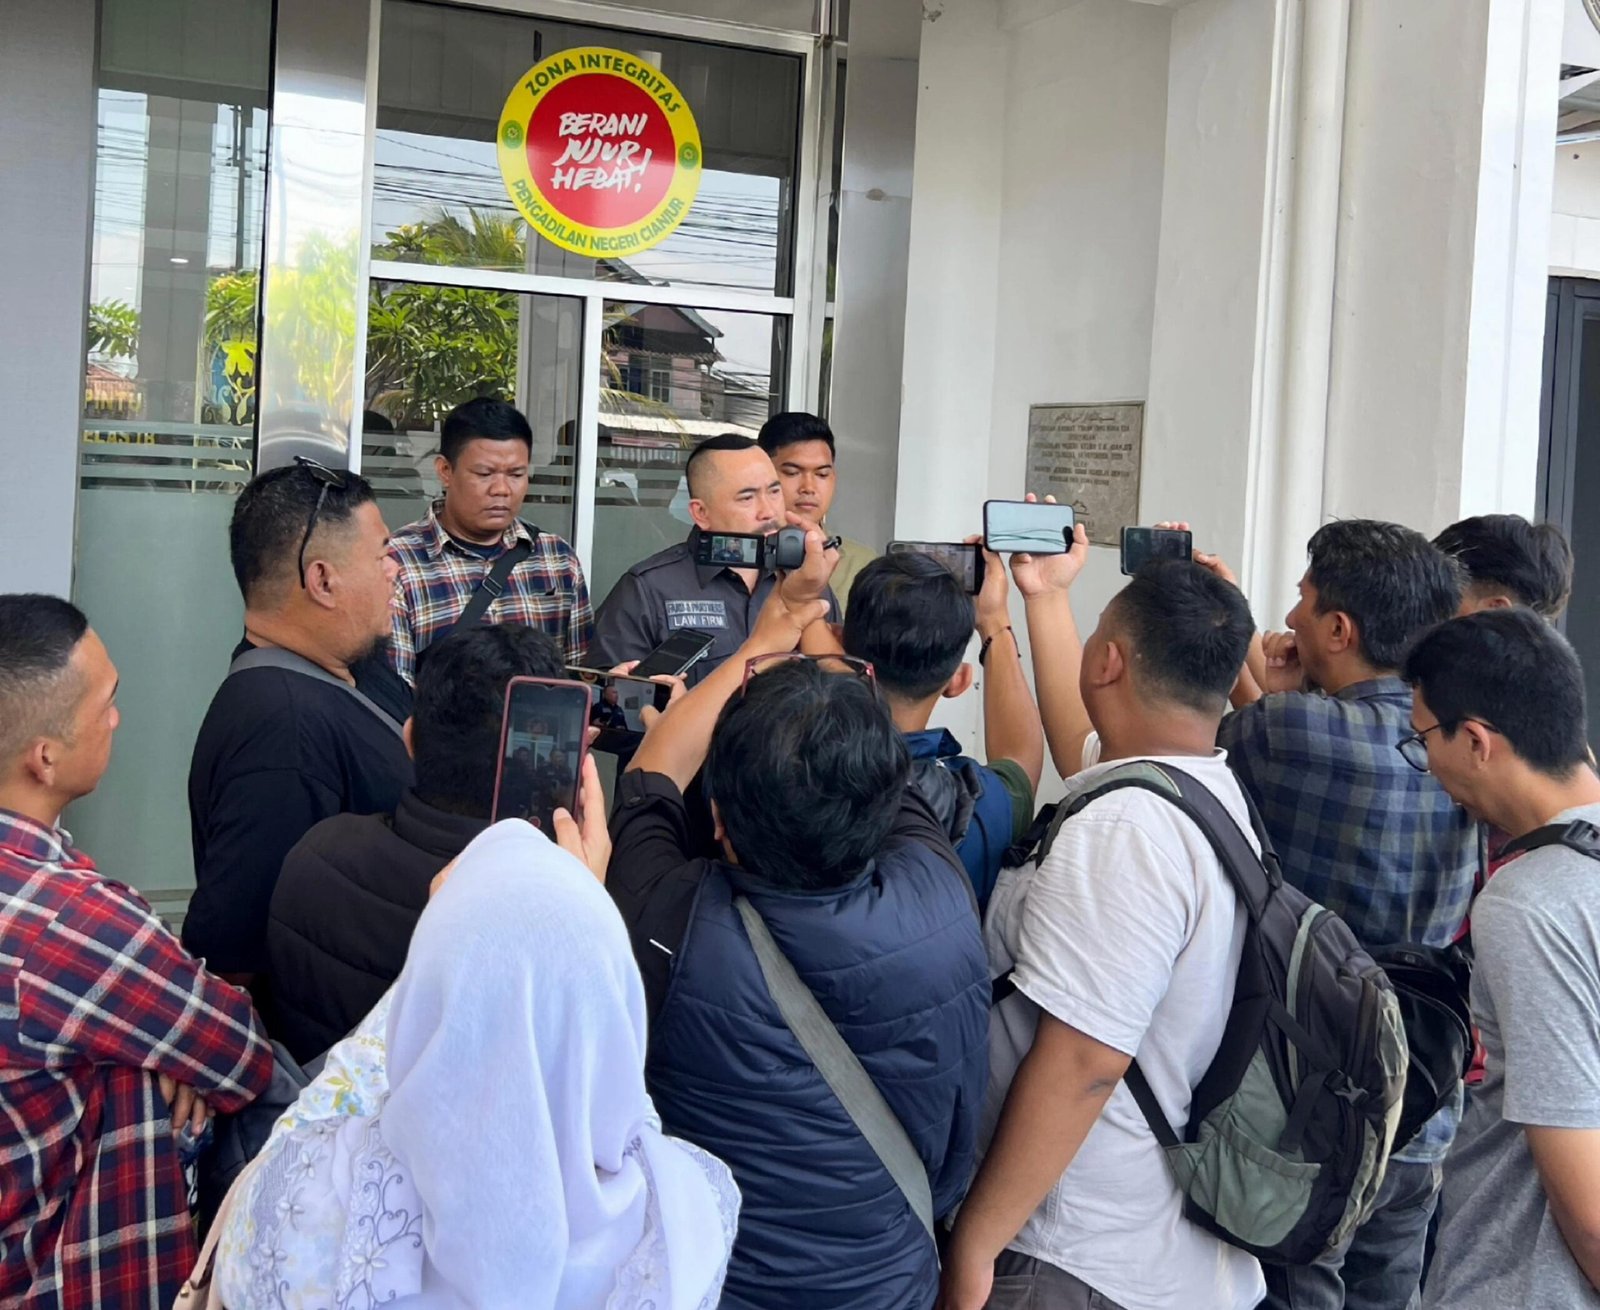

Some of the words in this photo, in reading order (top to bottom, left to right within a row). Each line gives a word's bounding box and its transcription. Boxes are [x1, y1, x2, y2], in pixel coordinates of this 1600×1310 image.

[525, 58, 576, 97] ZONA
[581, 54, 680, 113] INTEGRITAS
[558, 112, 648, 137] BERANI
[513, 178, 587, 249] PENGADILAN
[589, 233, 640, 251] NEGERI
[640, 197, 685, 242] CIANJUR
[674, 615, 696, 626] LAW
[702, 615, 724, 626] FIRM
